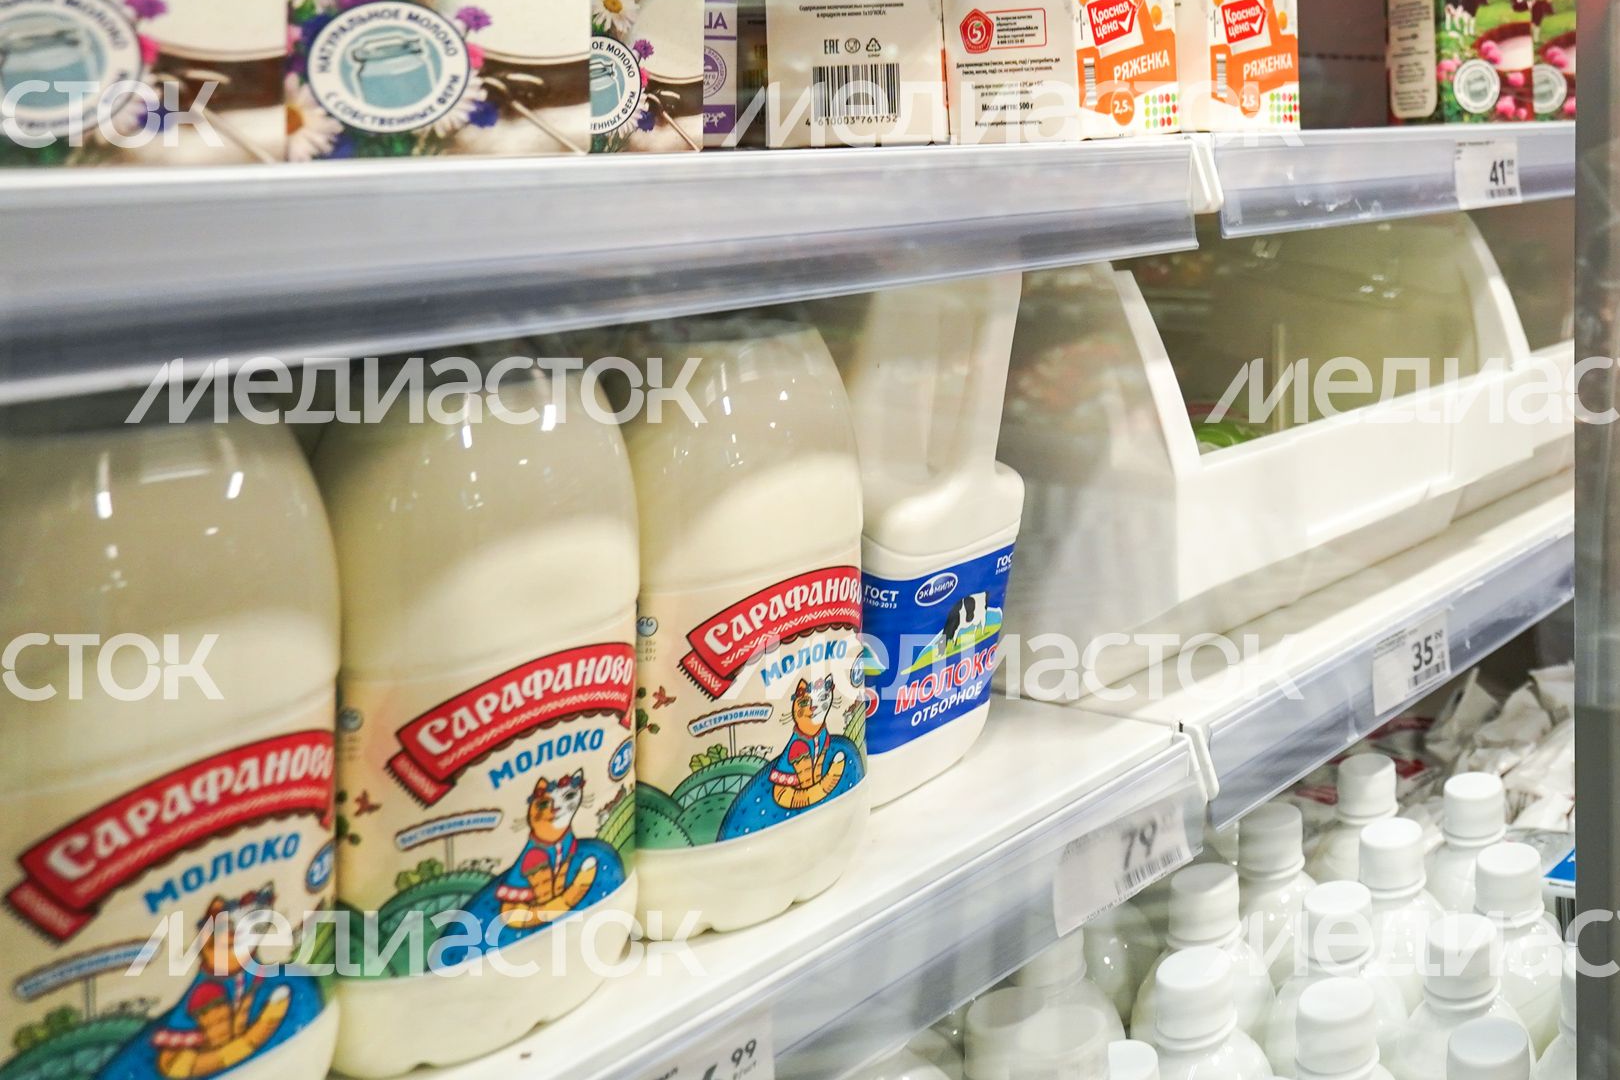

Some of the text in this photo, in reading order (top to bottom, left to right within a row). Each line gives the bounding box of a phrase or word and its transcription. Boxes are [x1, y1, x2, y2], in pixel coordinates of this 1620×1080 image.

[1090, 0, 1130, 25] Красная
[1224, 1, 1261, 26] Красная
[407, 11, 458, 58] МОЛОКО
[1095, 19, 1119, 40] цена
[1228, 20, 1250, 39] цена
[605, 42, 636, 79] МОЛОКО
[1113, 49, 1171, 84] РЯЖЕНКА
[1243, 52, 1293, 79] РЯЖЕНКА
[621, 89, 637, 115] ФЕРМ
[1019, 102, 1030, 110] 500
[1489, 160, 1506, 186] 41
[863, 583, 899, 602] ГОСТ
[760, 639, 848, 687] МОЛОКО
[1412, 634, 1433, 672] 35
[894, 644, 1001, 715] МОЛОКО
[911, 680, 983, 727] ОТБОРНОЕ
[692, 708, 770, 733] ПАСТЕРИЗОВАННОЕ
[487, 727, 605, 791] МОЛОКО
[1121, 819, 1158, 871] 79
[143, 831, 301, 915] МОЛОКО
[730, 1037, 757, 1068] 99
